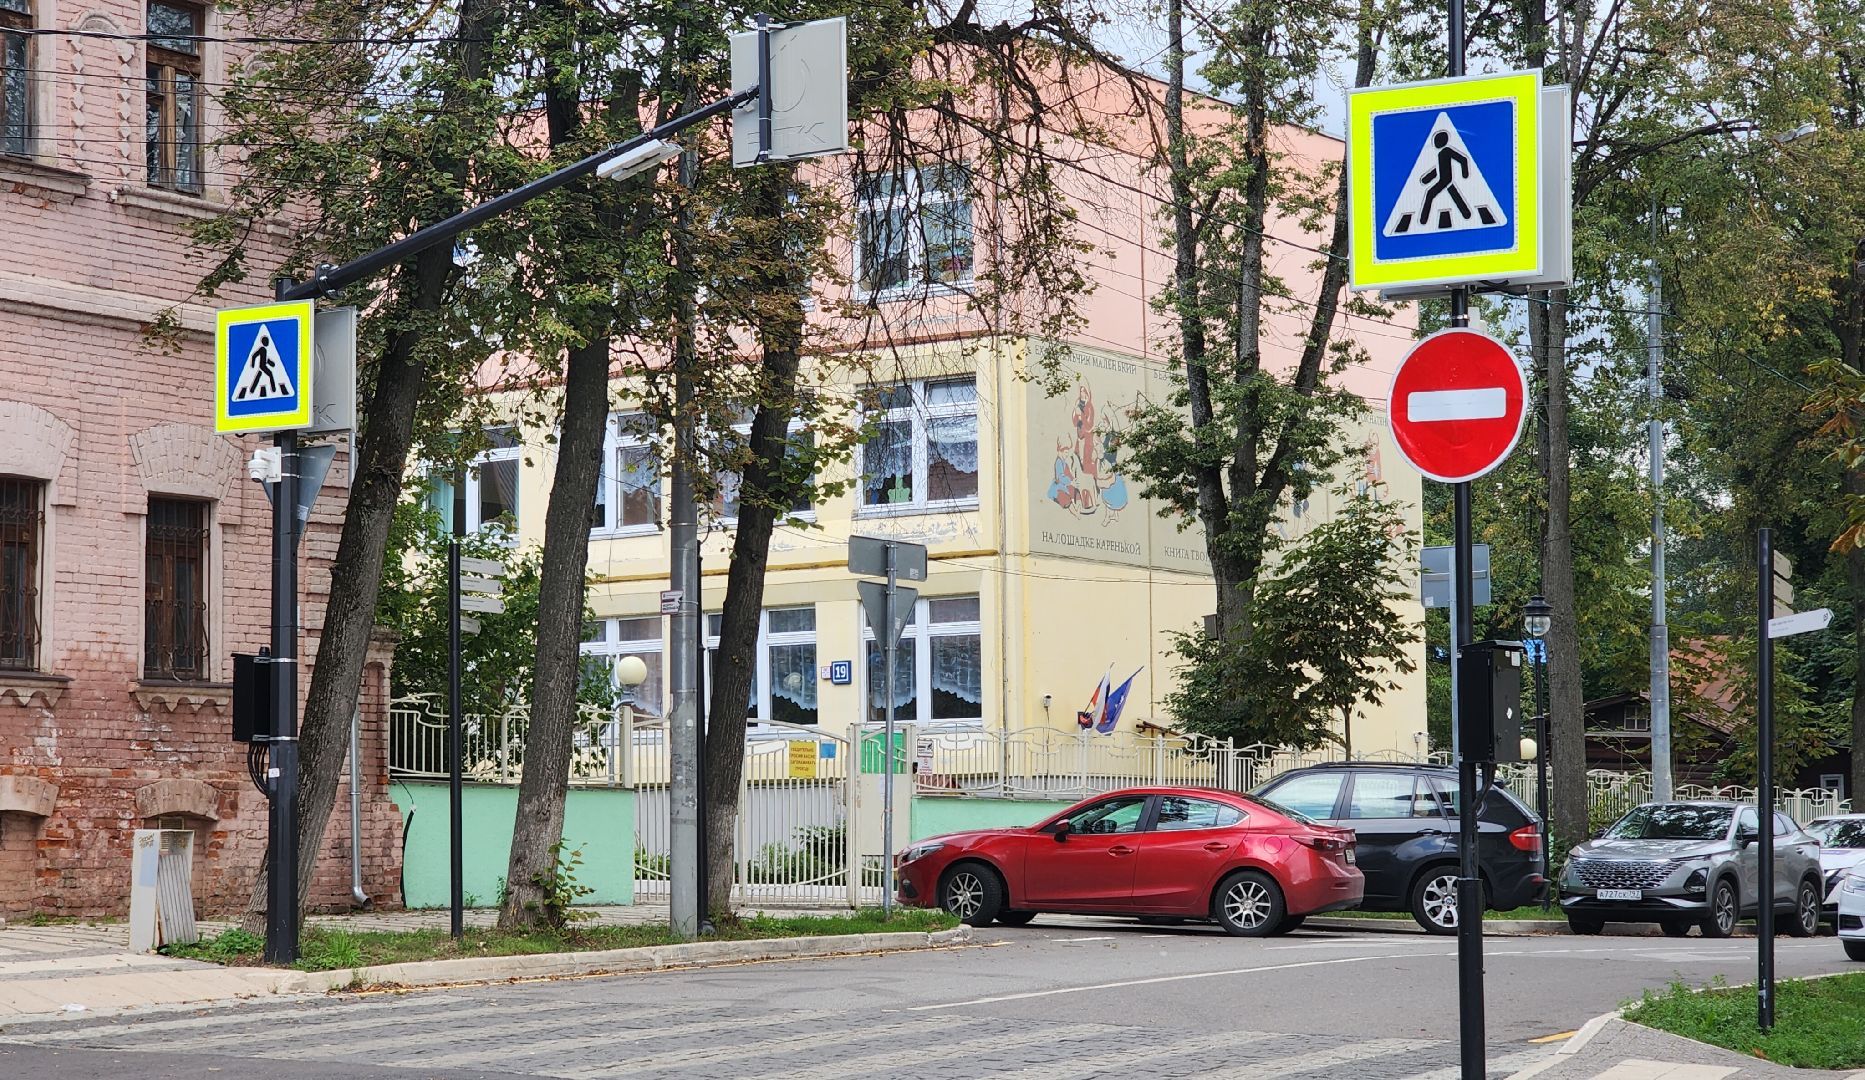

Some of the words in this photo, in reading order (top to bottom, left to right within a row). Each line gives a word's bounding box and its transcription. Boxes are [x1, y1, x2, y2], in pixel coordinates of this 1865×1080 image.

[1042, 531, 1053, 544] НА
[1055, 532, 1095, 549] ЛОШАДКЕ
[1096, 538, 1141, 555] КАРЕНЬКОЙ
[1164, 546, 1190, 560] КНИГА
[835, 665, 846, 678] 19
